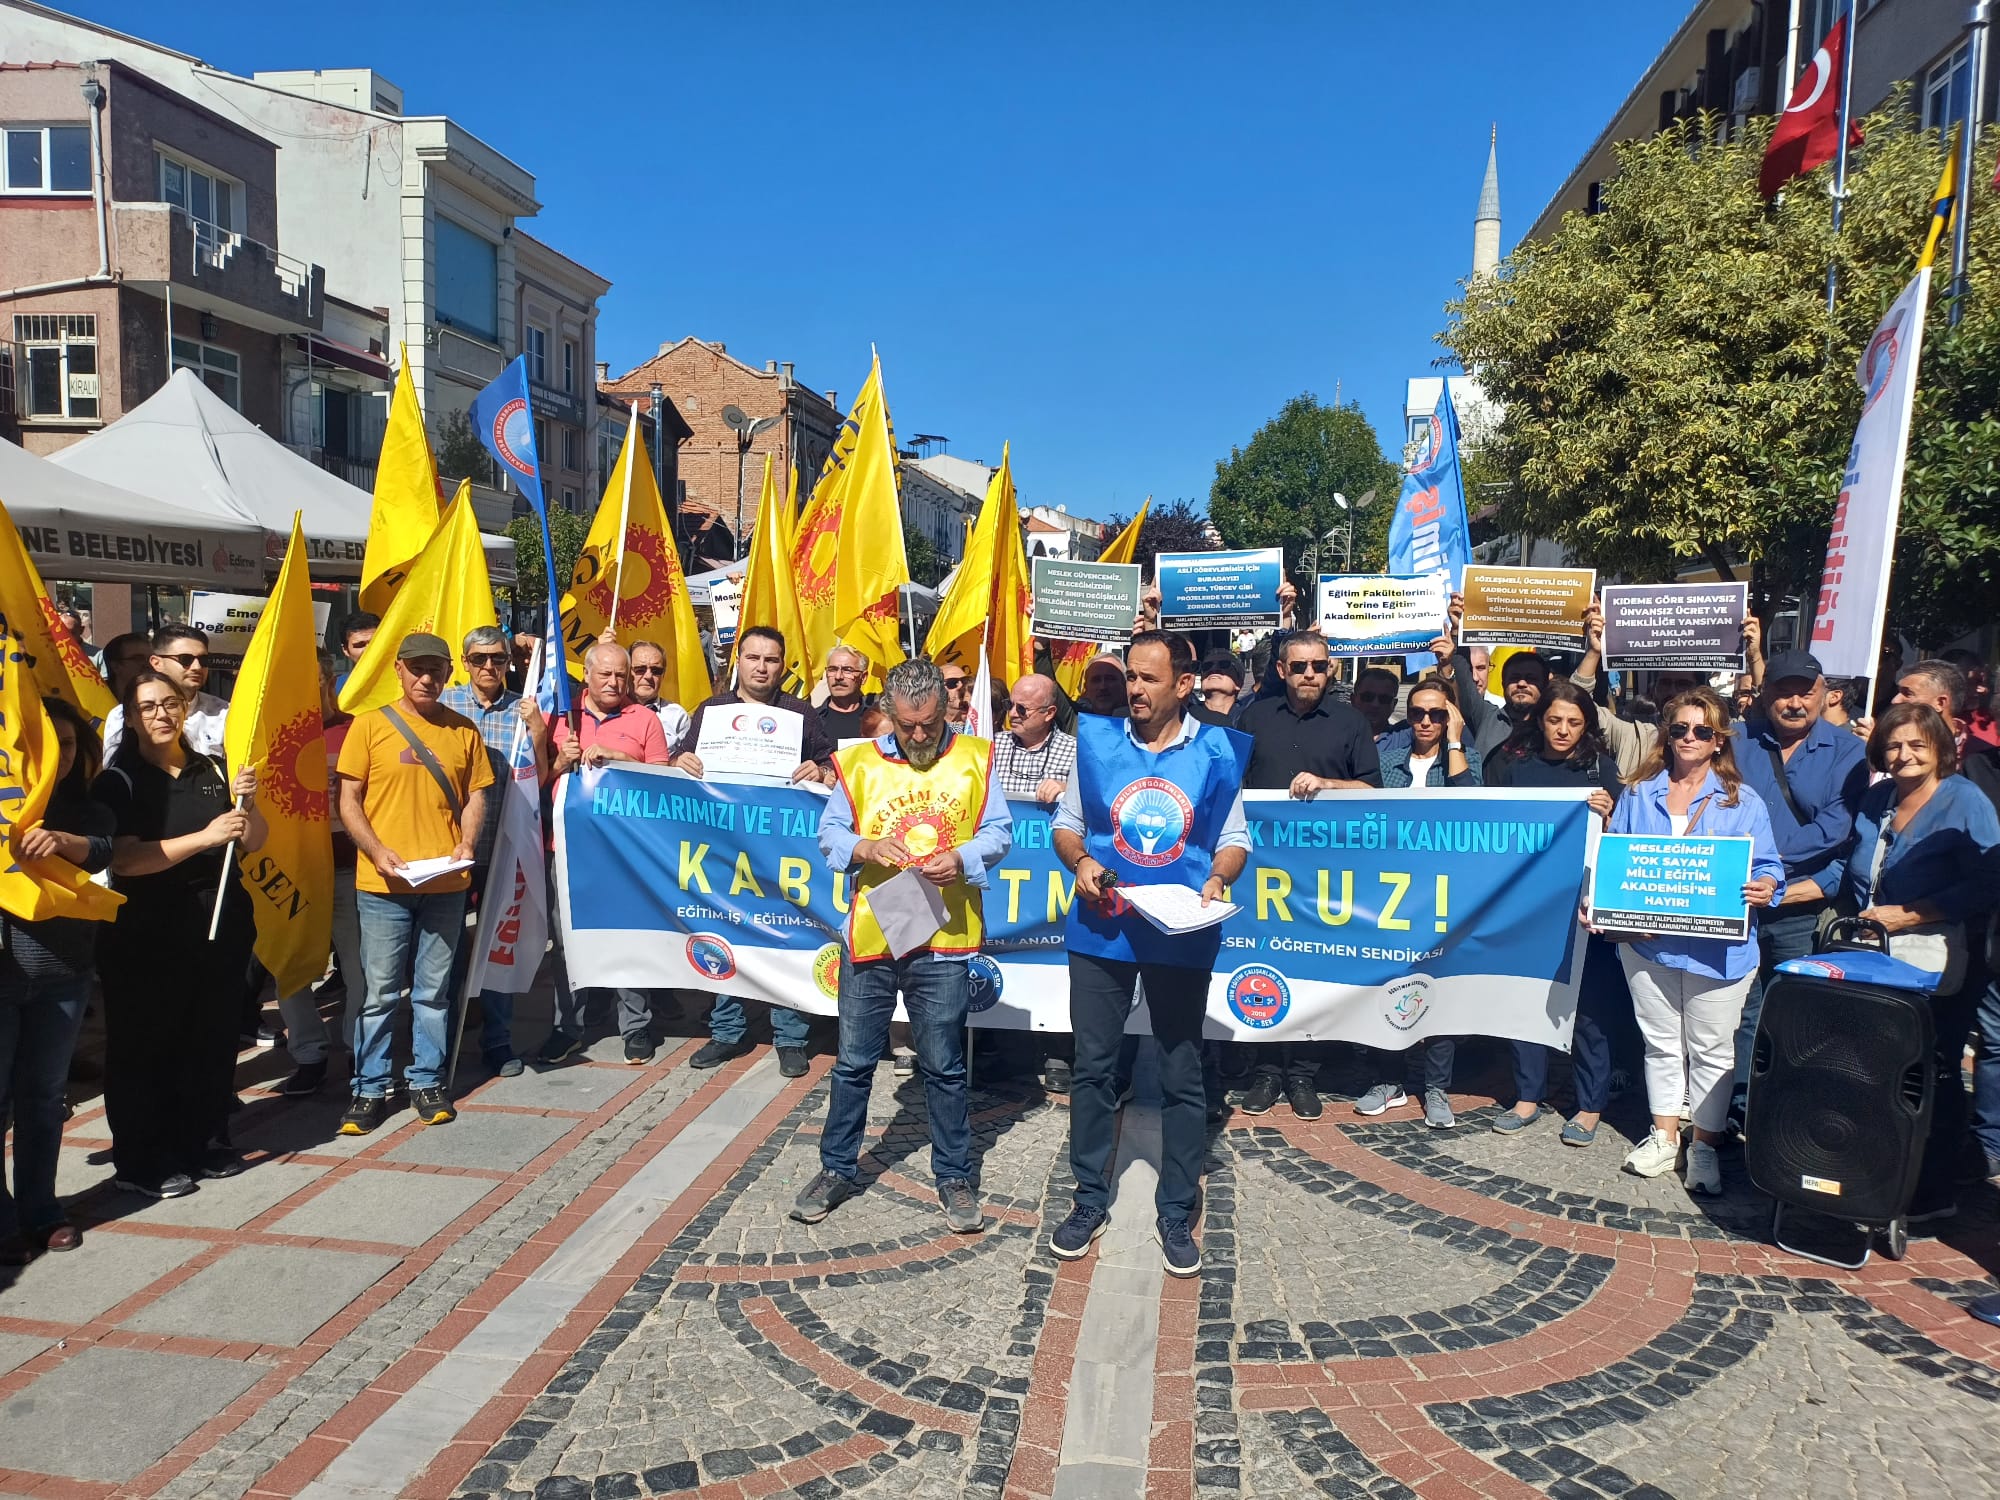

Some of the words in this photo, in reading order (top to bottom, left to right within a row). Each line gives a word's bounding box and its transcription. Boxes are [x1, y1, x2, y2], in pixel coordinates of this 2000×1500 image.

[68, 530, 204, 568] BELEDİYESİ
[1048, 569, 1072, 577] MESLEK
[1041, 587, 1064, 596] HİZMET
[1329, 590, 1359, 598] Eğitim
[1363, 589, 1436, 597] Fakültelerinin
[1383, 601, 1416, 609] Eğitim
[1655, 595, 1683, 604] GÖRE
[1687, 595, 1736, 603] SINAVSIZ
[1620, 607, 1672, 615] ÜNVANSIZ
[1676, 606, 1710, 614] ÜCRET
[1616, 618, 1675, 626] EMEKLİLİĞE
[592, 787, 735, 832] HAKLARIMIZI
[743, 804, 773, 836] VE
[1273, 812, 1387, 850] MESLEĞİ
[870, 790, 931, 836] EĞİTİM
[940, 792, 969, 822] SEN
[1628, 843, 1714, 856] MESLEĞİMİZİ
[1632, 856, 1658, 865] YOK
[1662, 857, 1708, 868] SAYAN
[678, 840, 849, 914] KABU
[1665, 869, 1711, 881] EĞİTİM
[248, 856, 310, 920] SEN
[1620, 882, 1716, 896] AKADEMİSİ'NE
[1645, 896, 1689, 907] HAYIR!
[676, 905, 741, 925] EĞİTİM-İŞ
[1270, 936, 1358, 958] ÖĞRETMEN
[1361, 946, 1444, 962] SENDİKASI
